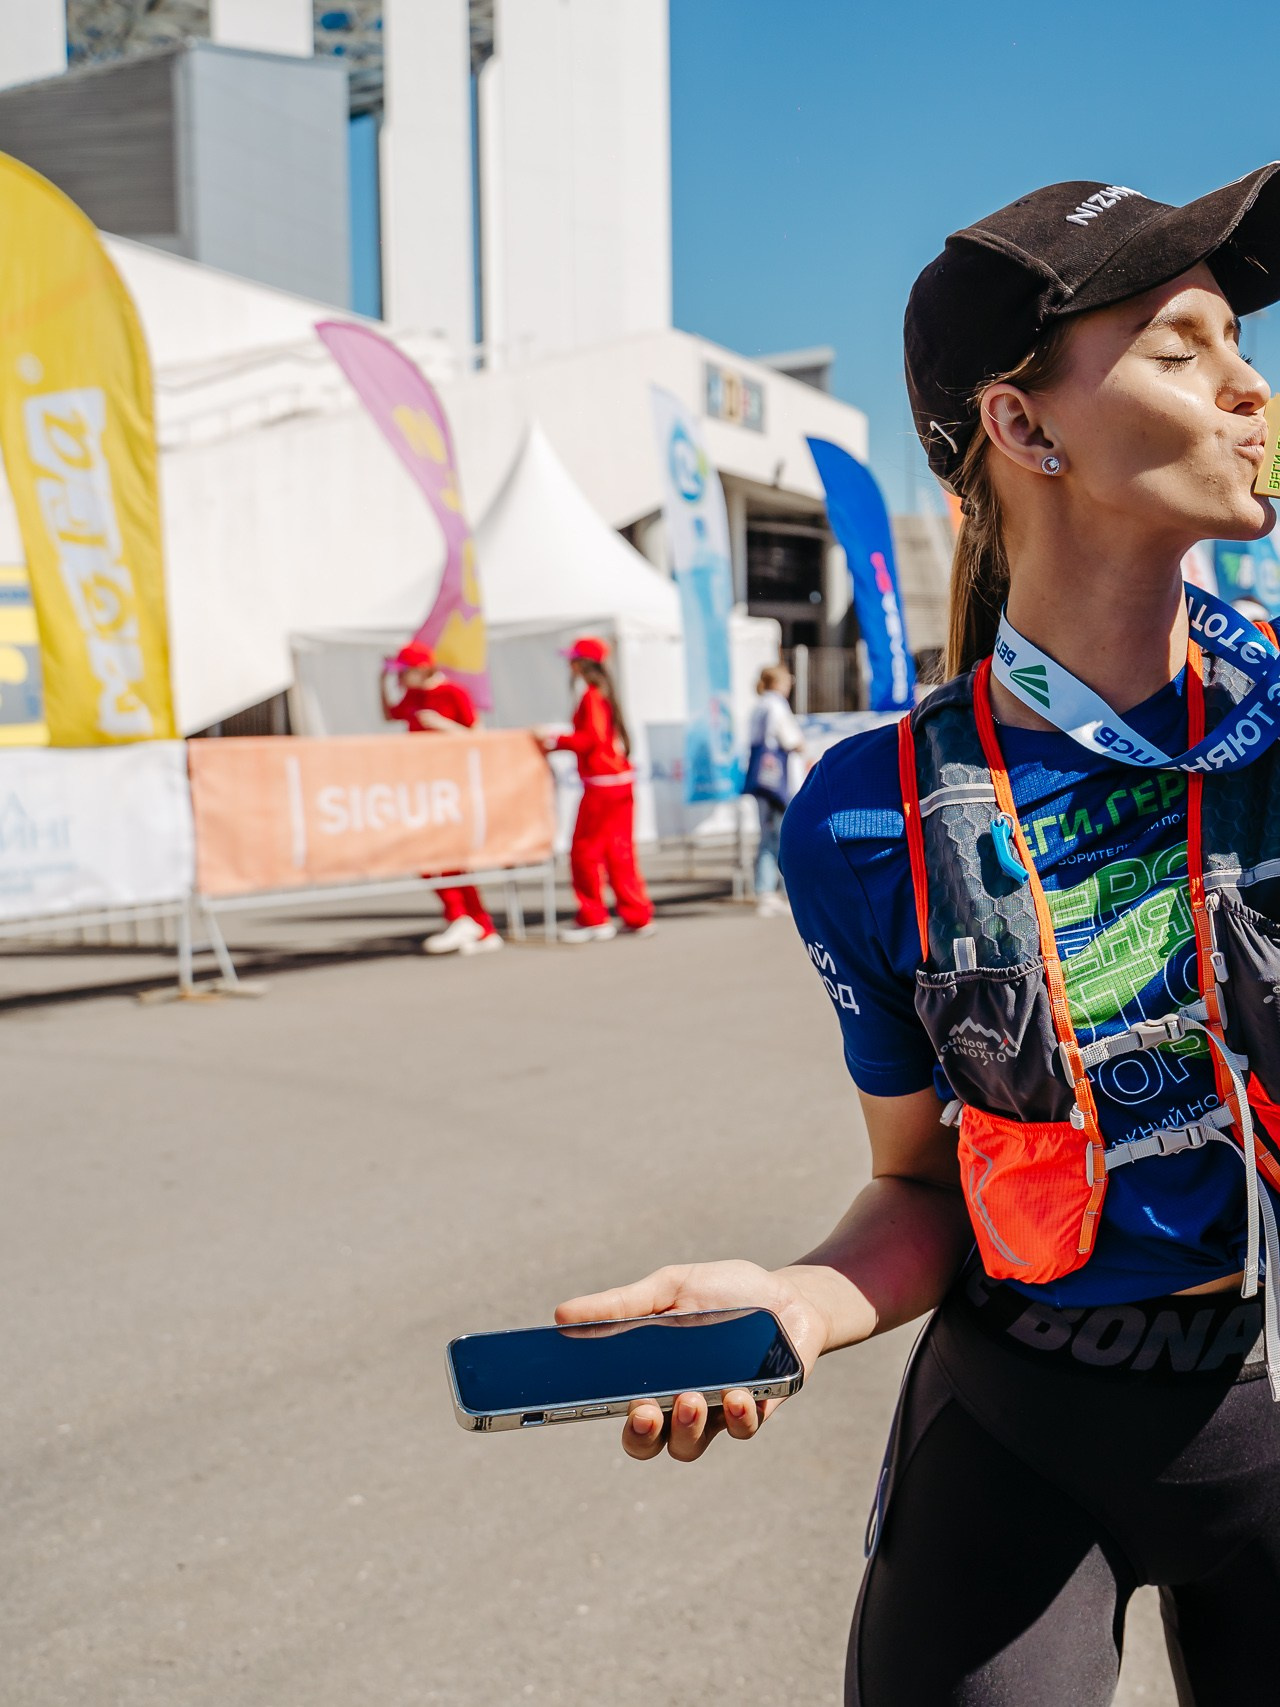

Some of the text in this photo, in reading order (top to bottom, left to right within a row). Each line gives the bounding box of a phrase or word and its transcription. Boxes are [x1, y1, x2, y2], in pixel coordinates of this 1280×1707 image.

[1066, 185, 1147, 226] NIZH
[1095, 726, 1156, 764] ПСБ
[1160, 702, 1275, 773] НЯЮТ
[317, 779, 463, 835] SIGUR
[940, 1036, 988, 1053] outdoor
[1006, 1301, 1265, 1373] BONA
